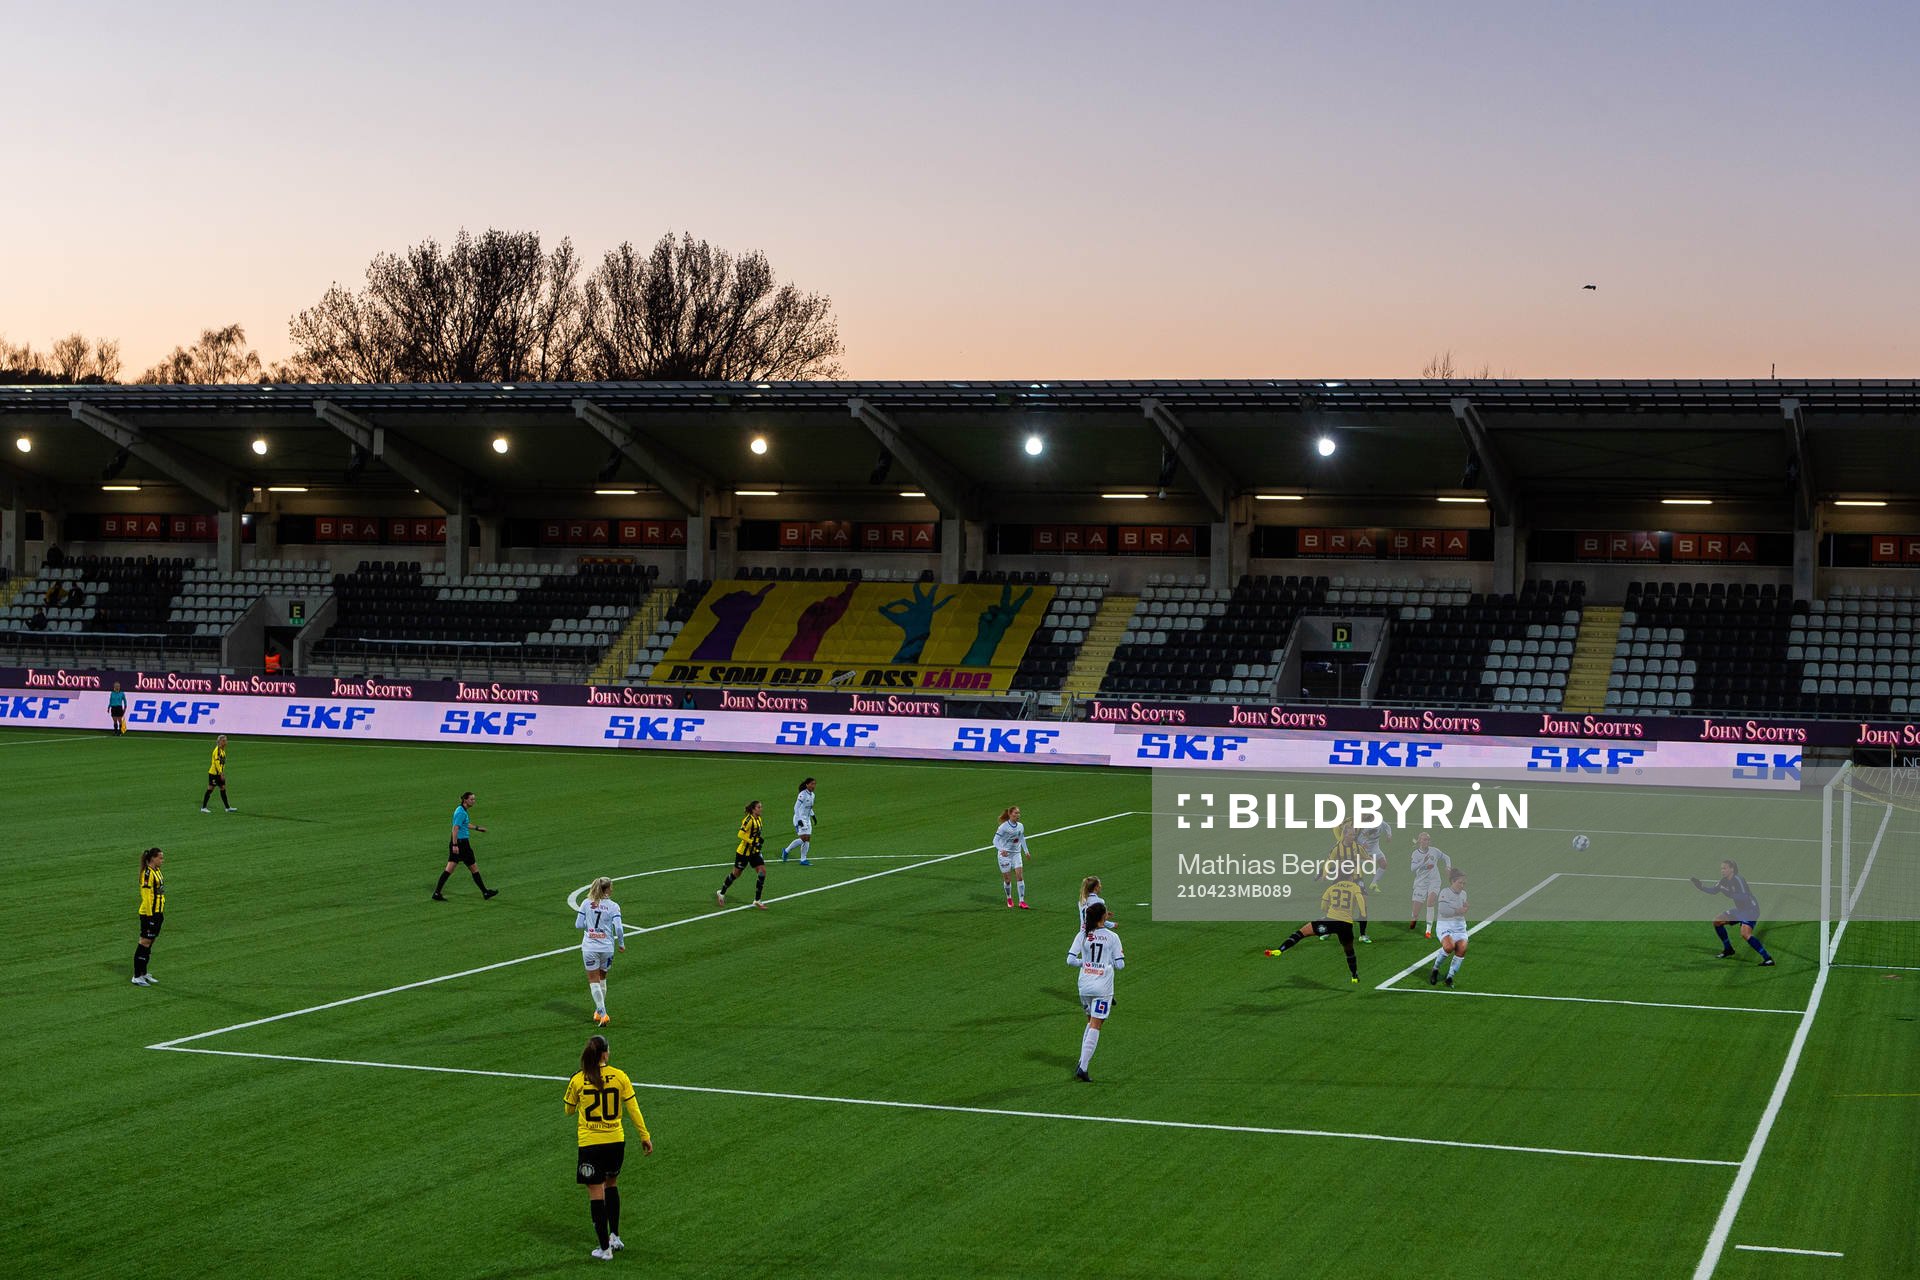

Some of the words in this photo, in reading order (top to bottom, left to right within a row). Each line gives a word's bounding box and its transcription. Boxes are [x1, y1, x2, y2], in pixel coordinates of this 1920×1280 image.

[106, 520, 158, 532] BRA
[320, 523, 376, 535] BRA
[547, 526, 606, 537] BRA
[624, 526, 683, 537] BRA
[786, 528, 849, 540] BRA
[867, 529, 929, 541] BRA
[1039, 532, 1104, 544] BRA
[1124, 533, 1189, 544] BRA
[1304, 535, 1372, 547] BRA
[1394, 536, 1463, 549] BRA
[1584, 539, 1656, 551] BRA
[1679, 540, 1751, 552] BRA
[293, 606, 302, 618] E
[1336, 628, 1348, 641] D
[26, 670, 54, 686] JOHN
[58, 670, 99, 687] SCOTT'S
[135, 673, 164, 689] JOHN
[168, 674, 211, 690] SCOTT'S
[668, 666, 703, 682] DE
[218, 675, 248, 691] JOHN
[251, 676, 295, 692] SCOTT'S
[332, 679, 363, 695] JOHN
[366, 680, 411, 697] SCOTT'S
[455, 683, 487, 700] JOHN
[491, 684, 538, 701] SCOTT'S
[587, 687, 620, 704] JOHN
[624, 688, 671, 705] SCOTT'S
[720, 691, 753, 708] JOHN
[758, 692, 806, 709] SCOTT'S
[850, 695, 884, 712] JOHN
[889, 696, 939, 714] SCOTT'S
[128, 700, 220, 724] SKF
[281, 705, 376, 730] SKF
[1091, 702, 1127, 719] JOHN
[1132, 703, 1184, 721] SCOTT'S
[1229, 706, 1266, 723] JOHN
[1271, 707, 1325, 725] SCOTT'S
[1380, 710, 1418, 728] JOHN
[1423, 711, 1480, 730] SCOTT'S
[440, 710, 537, 736] SKF
[604, 715, 705, 742] SKF
[1540, 715, 1579, 732] JOHN
[1584, 716, 1641, 735] SCOTT'S
[1701, 720, 1741, 738] JOHN
[1746, 721, 1805, 740] SCOTT'S
[775, 721, 879, 748] SKF
[952, 727, 1060, 755] SKF
[1857, 724, 1898, 743] JOHN
[1136, 732, 1248, 761] SKF
[1328, 739, 1444, 767] SKF
[1527, 745, 1644, 773] SKF
[1332, 888, 1352, 909] 33
[594, 910, 602, 928] 7
[1090, 942, 1103, 963] 17
[583, 1087, 620, 1121] 20
